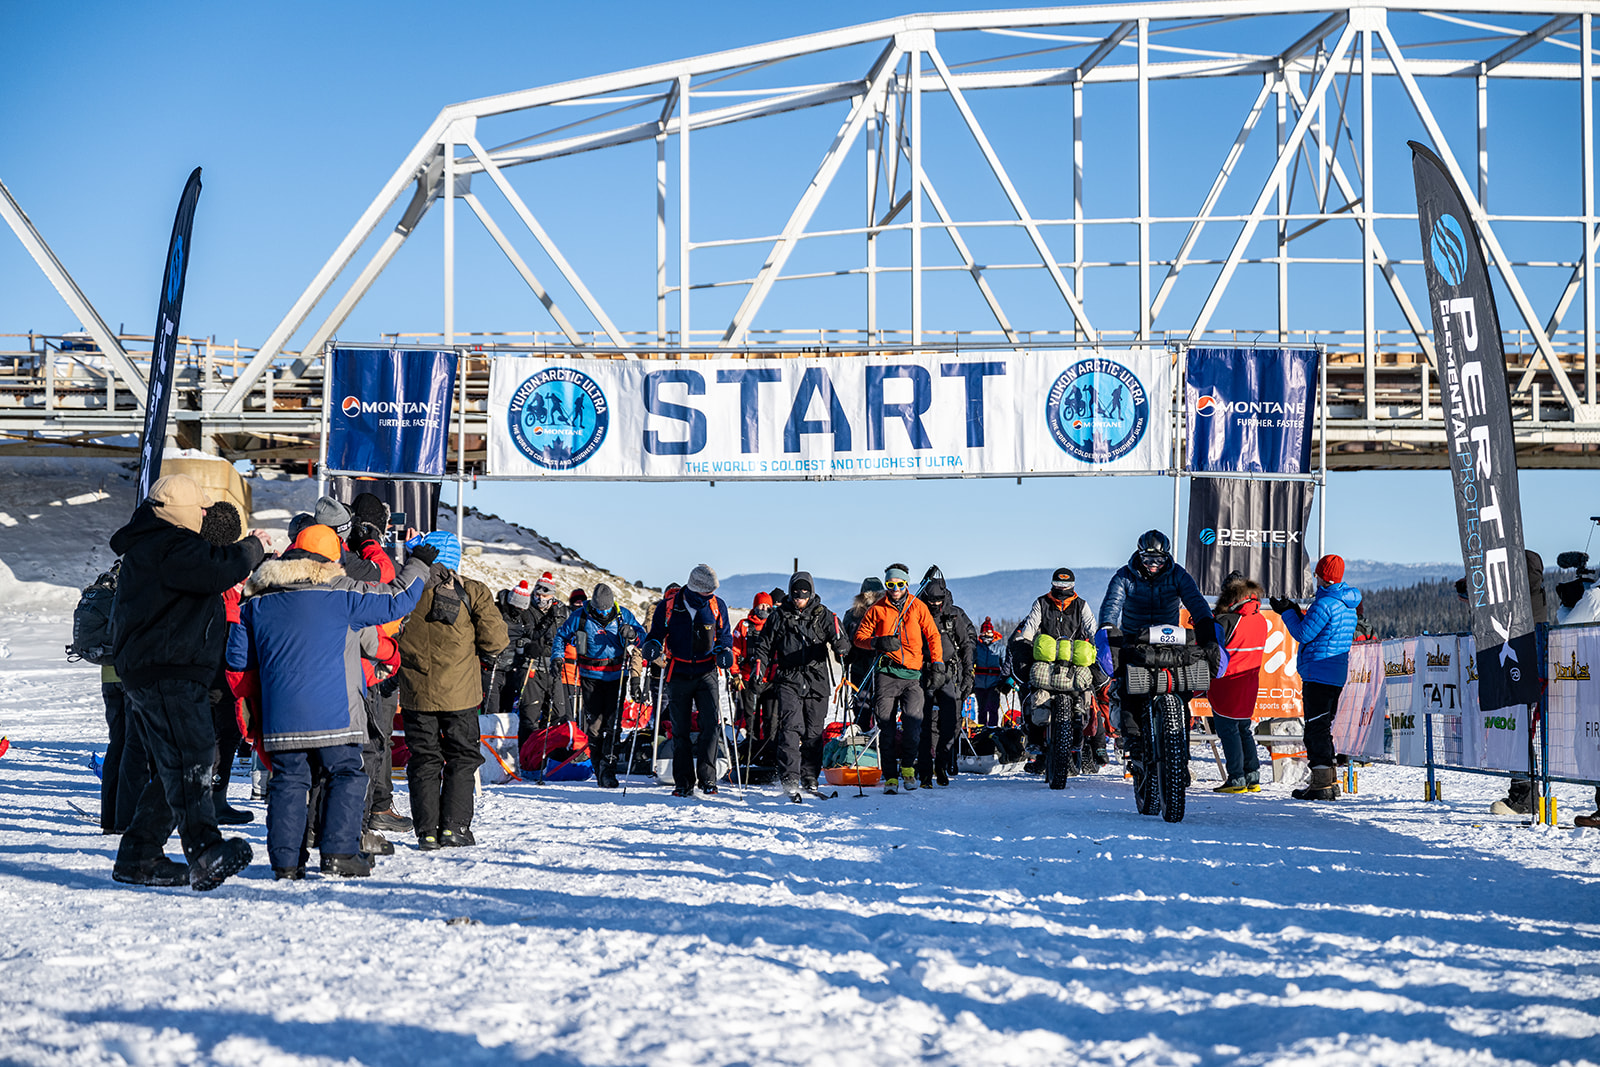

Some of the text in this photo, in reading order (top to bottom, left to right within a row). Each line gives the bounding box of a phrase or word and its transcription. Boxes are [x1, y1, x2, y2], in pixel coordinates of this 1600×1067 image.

[1049, 360, 1145, 406] YUKON ARCTIC ULTRA
[510, 369, 607, 415] YUKON ARCTIC ULTRA
[362, 401, 440, 415] MONTANE
[643, 361, 1006, 456] START
[1218, 401, 1304, 414] MONTANE
[543, 428, 584, 436] MONTANE
[1440, 300, 1487, 608] ELEMENTAL PROTECTION
[685, 455, 963, 472] THE WORLD'S COLDEST AND TOUGHEST ULTRA
[1449, 297, 1519, 668] PERTEX
[1217, 528, 1299, 543] PERTEX
[1160, 635, 1176, 643] 623
[1259, 702, 1280, 710] sports
